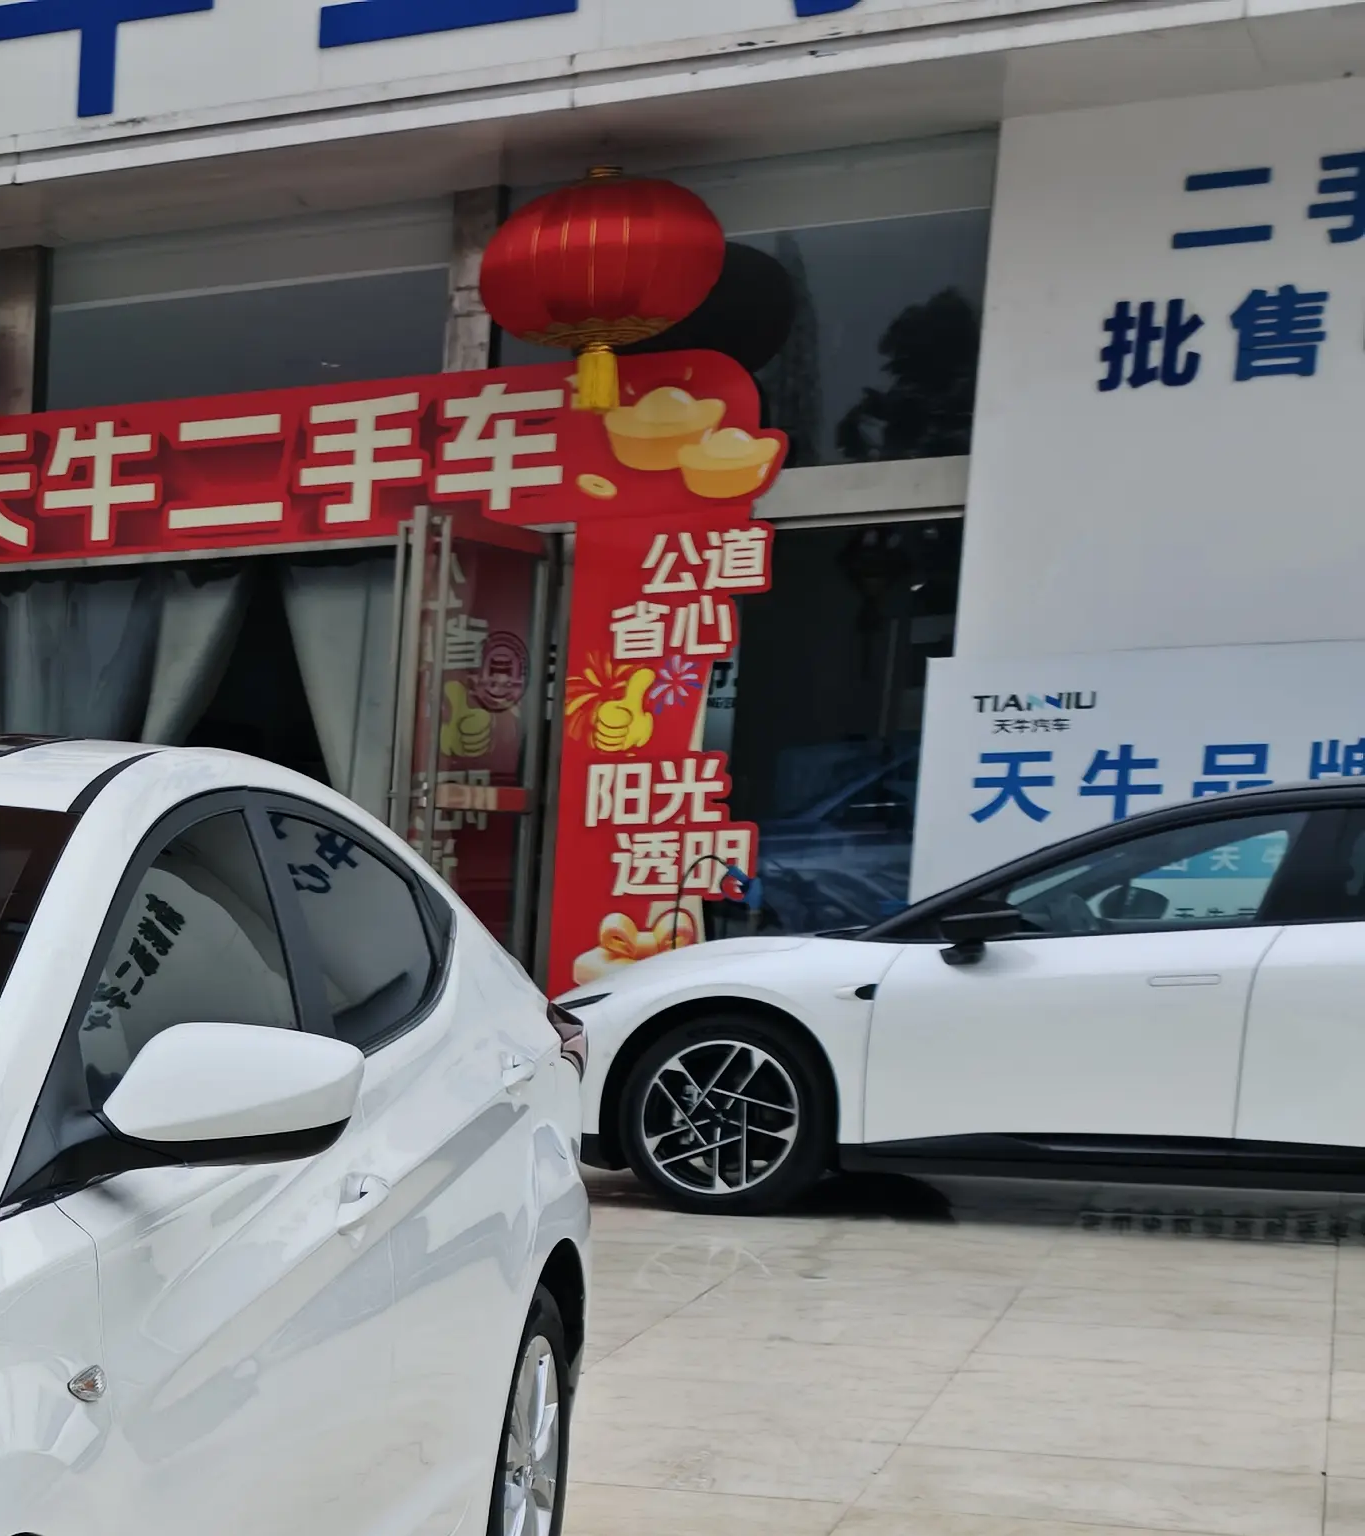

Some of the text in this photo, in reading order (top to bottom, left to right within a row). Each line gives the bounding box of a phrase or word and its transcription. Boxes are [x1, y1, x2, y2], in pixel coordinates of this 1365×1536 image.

[1097, 284, 1330, 392] 批售
[642, 527, 769, 594] 公道
[608, 595, 733, 660] 省心
[992, 718, 1072, 735] 天牛汽车
[585, 758, 726, 828] 阳光
[610, 829, 752, 897] 透明
